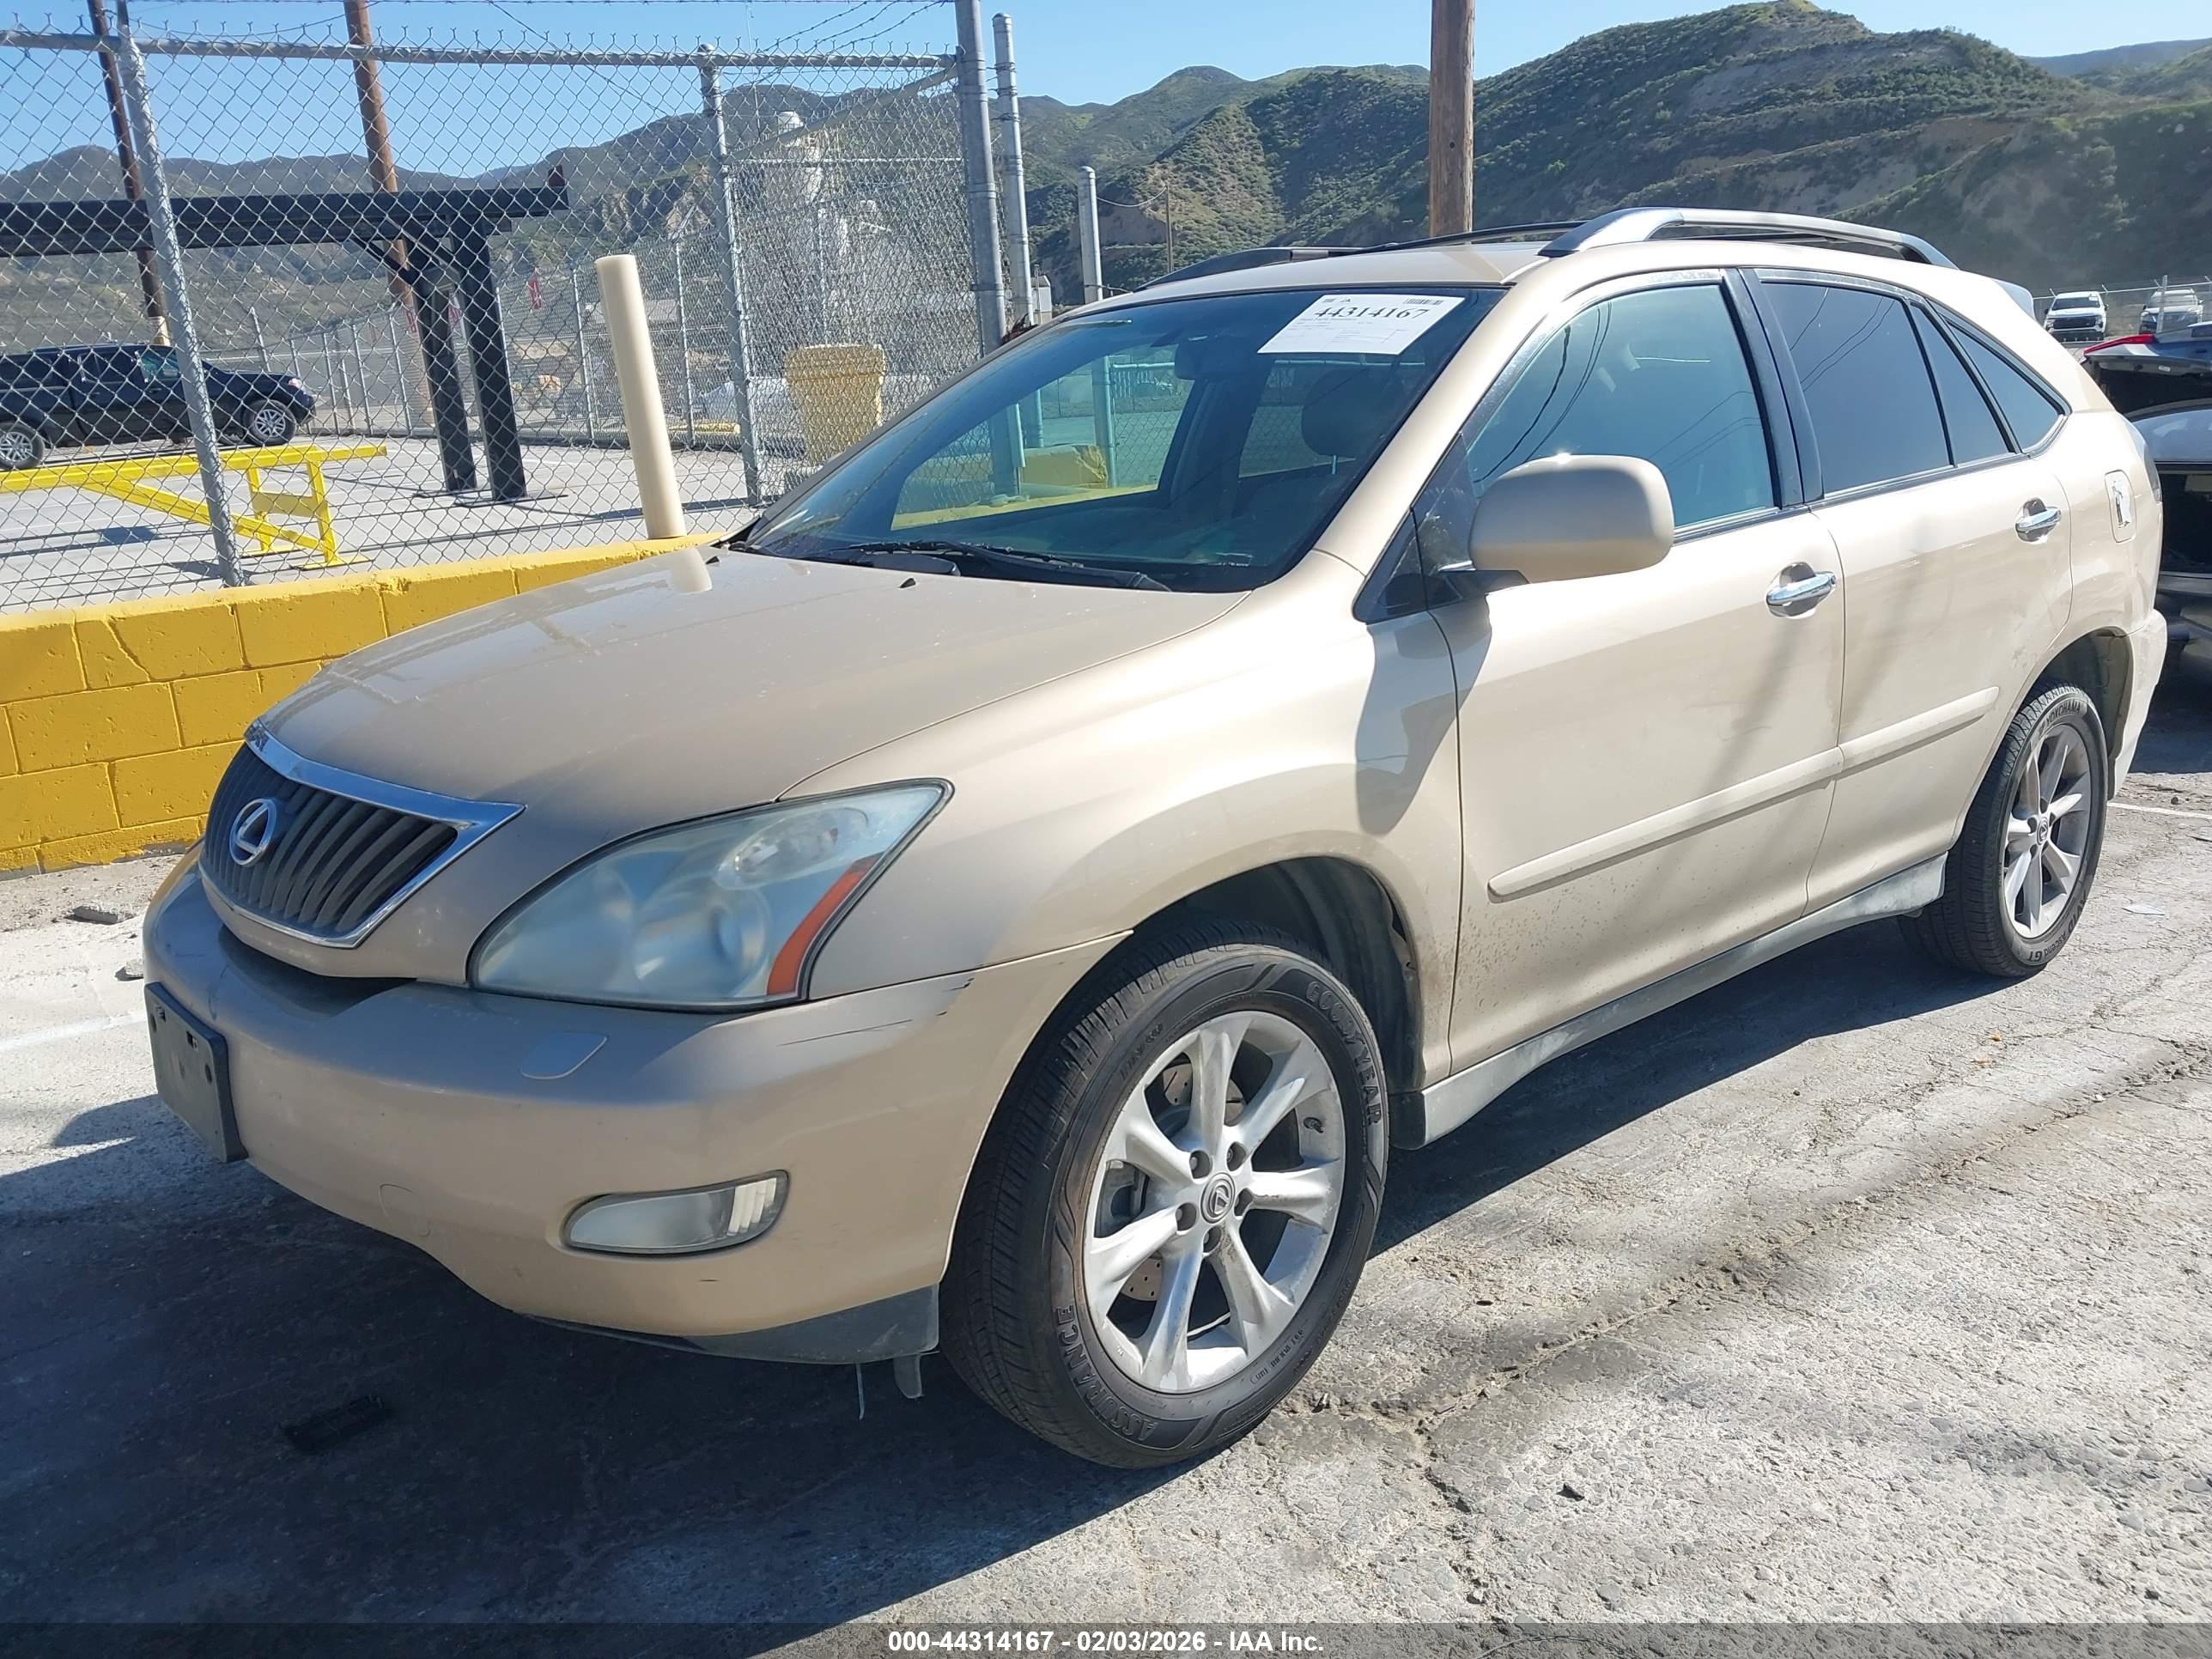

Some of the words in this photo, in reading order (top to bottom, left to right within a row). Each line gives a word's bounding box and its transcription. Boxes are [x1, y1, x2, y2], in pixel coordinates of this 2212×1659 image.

[1315, 306, 1431, 319] 44314167
[2045, 699, 2081, 726] YOKOHAMA
[2027, 950, 2043, 963] GT
[1305, 981, 1382, 1127] GOODYEAR
[1056, 1304, 1159, 1441] ASSURANCE
